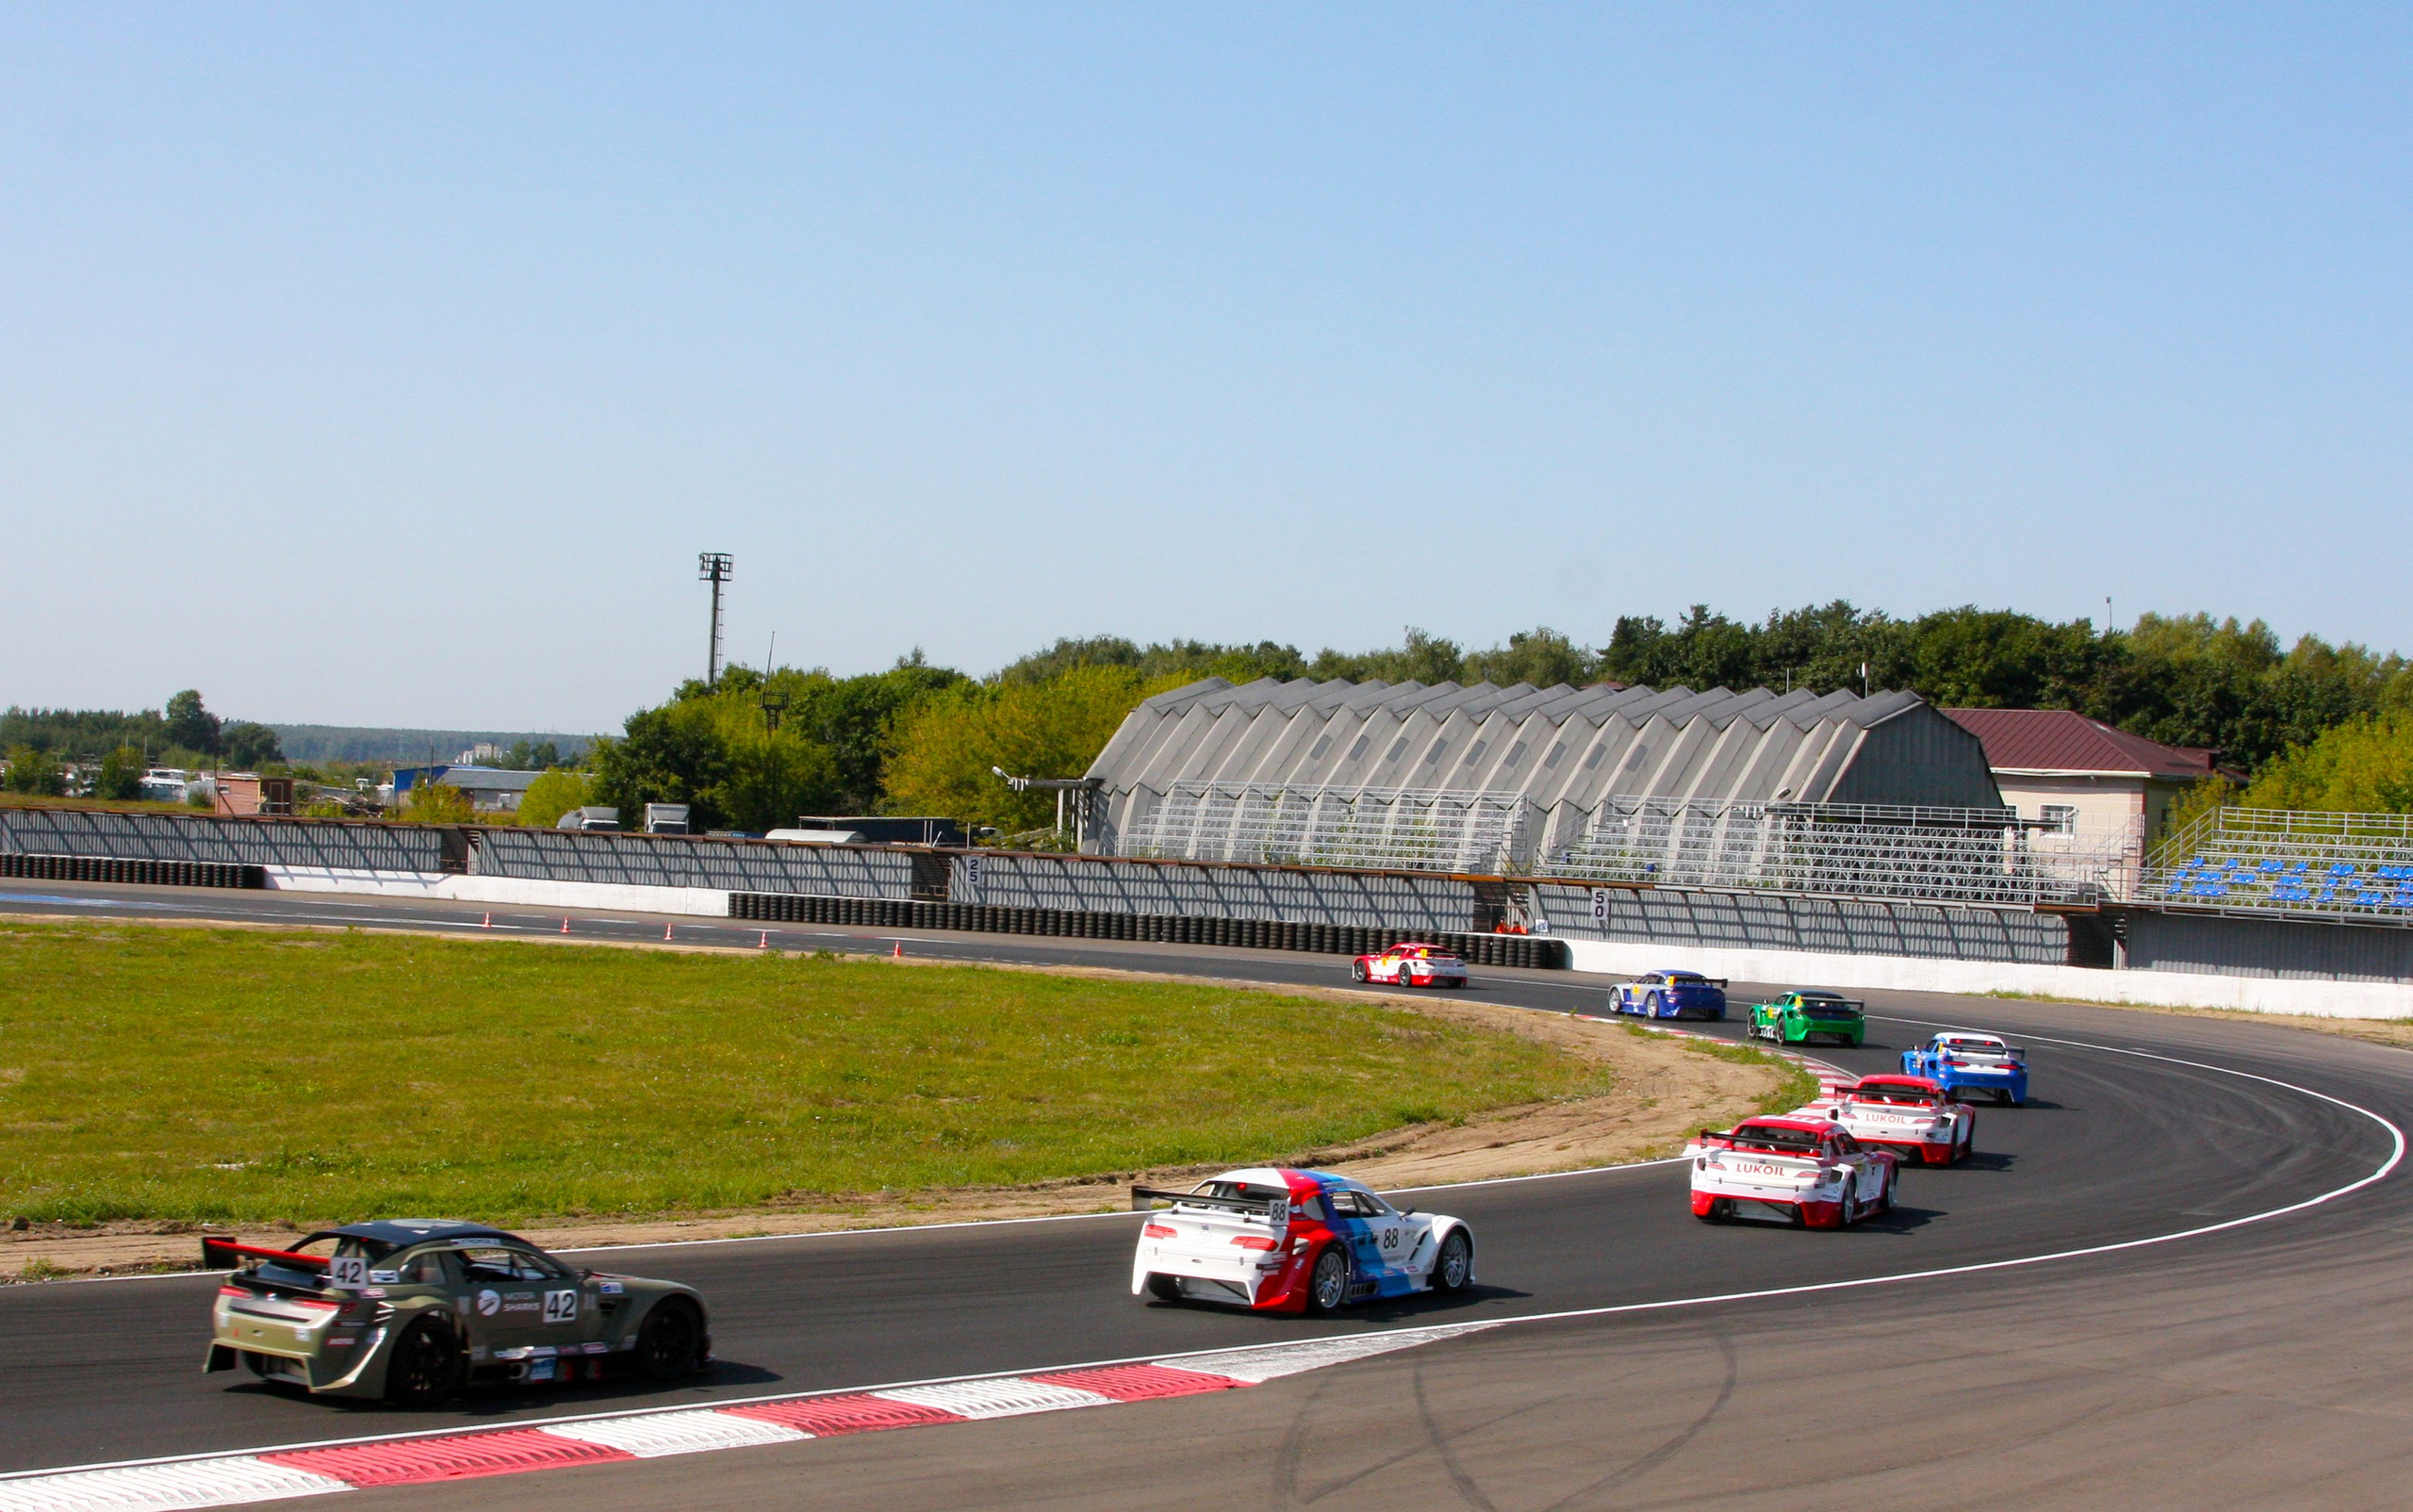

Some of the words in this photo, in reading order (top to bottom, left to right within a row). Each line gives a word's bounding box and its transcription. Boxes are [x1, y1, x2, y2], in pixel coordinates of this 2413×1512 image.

[969, 859, 979, 882] 25
[1595, 892, 1605, 918] 50
[1865, 1113, 1906, 1125] LUKOIL
[1736, 1163, 1786, 1176] LUKOIL
[1272, 1203, 1287, 1221] 88
[1383, 1227, 1399, 1250] 88
[336, 1261, 362, 1284] 42
[502, 1302, 542, 1312] SHARKS
[547, 1292, 575, 1319] 42
